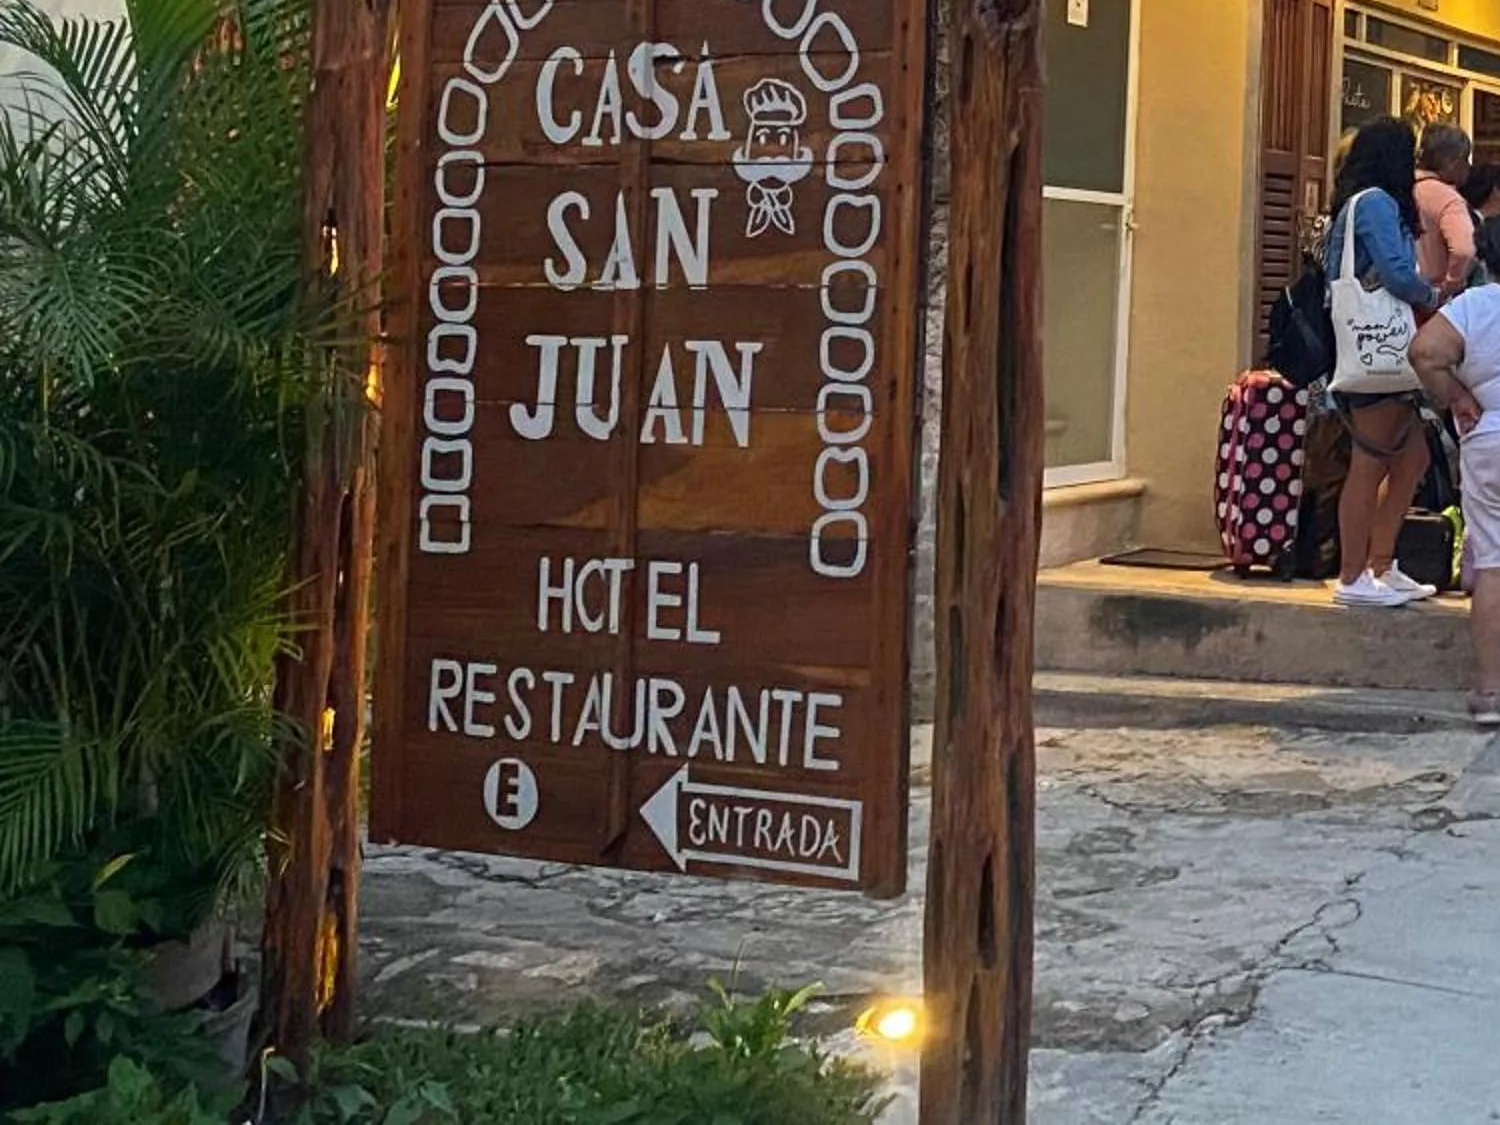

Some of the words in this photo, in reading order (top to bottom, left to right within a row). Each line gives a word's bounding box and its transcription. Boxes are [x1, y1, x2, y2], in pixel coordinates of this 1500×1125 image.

[536, 40, 730, 147] CASA
[543, 187, 719, 292] SAN
[508, 333, 764, 448] JUAN
[537, 556, 721, 644] HOTEL
[427, 658, 843, 771] RESTAURANTE
[689, 797, 842, 863] ENTRADA
